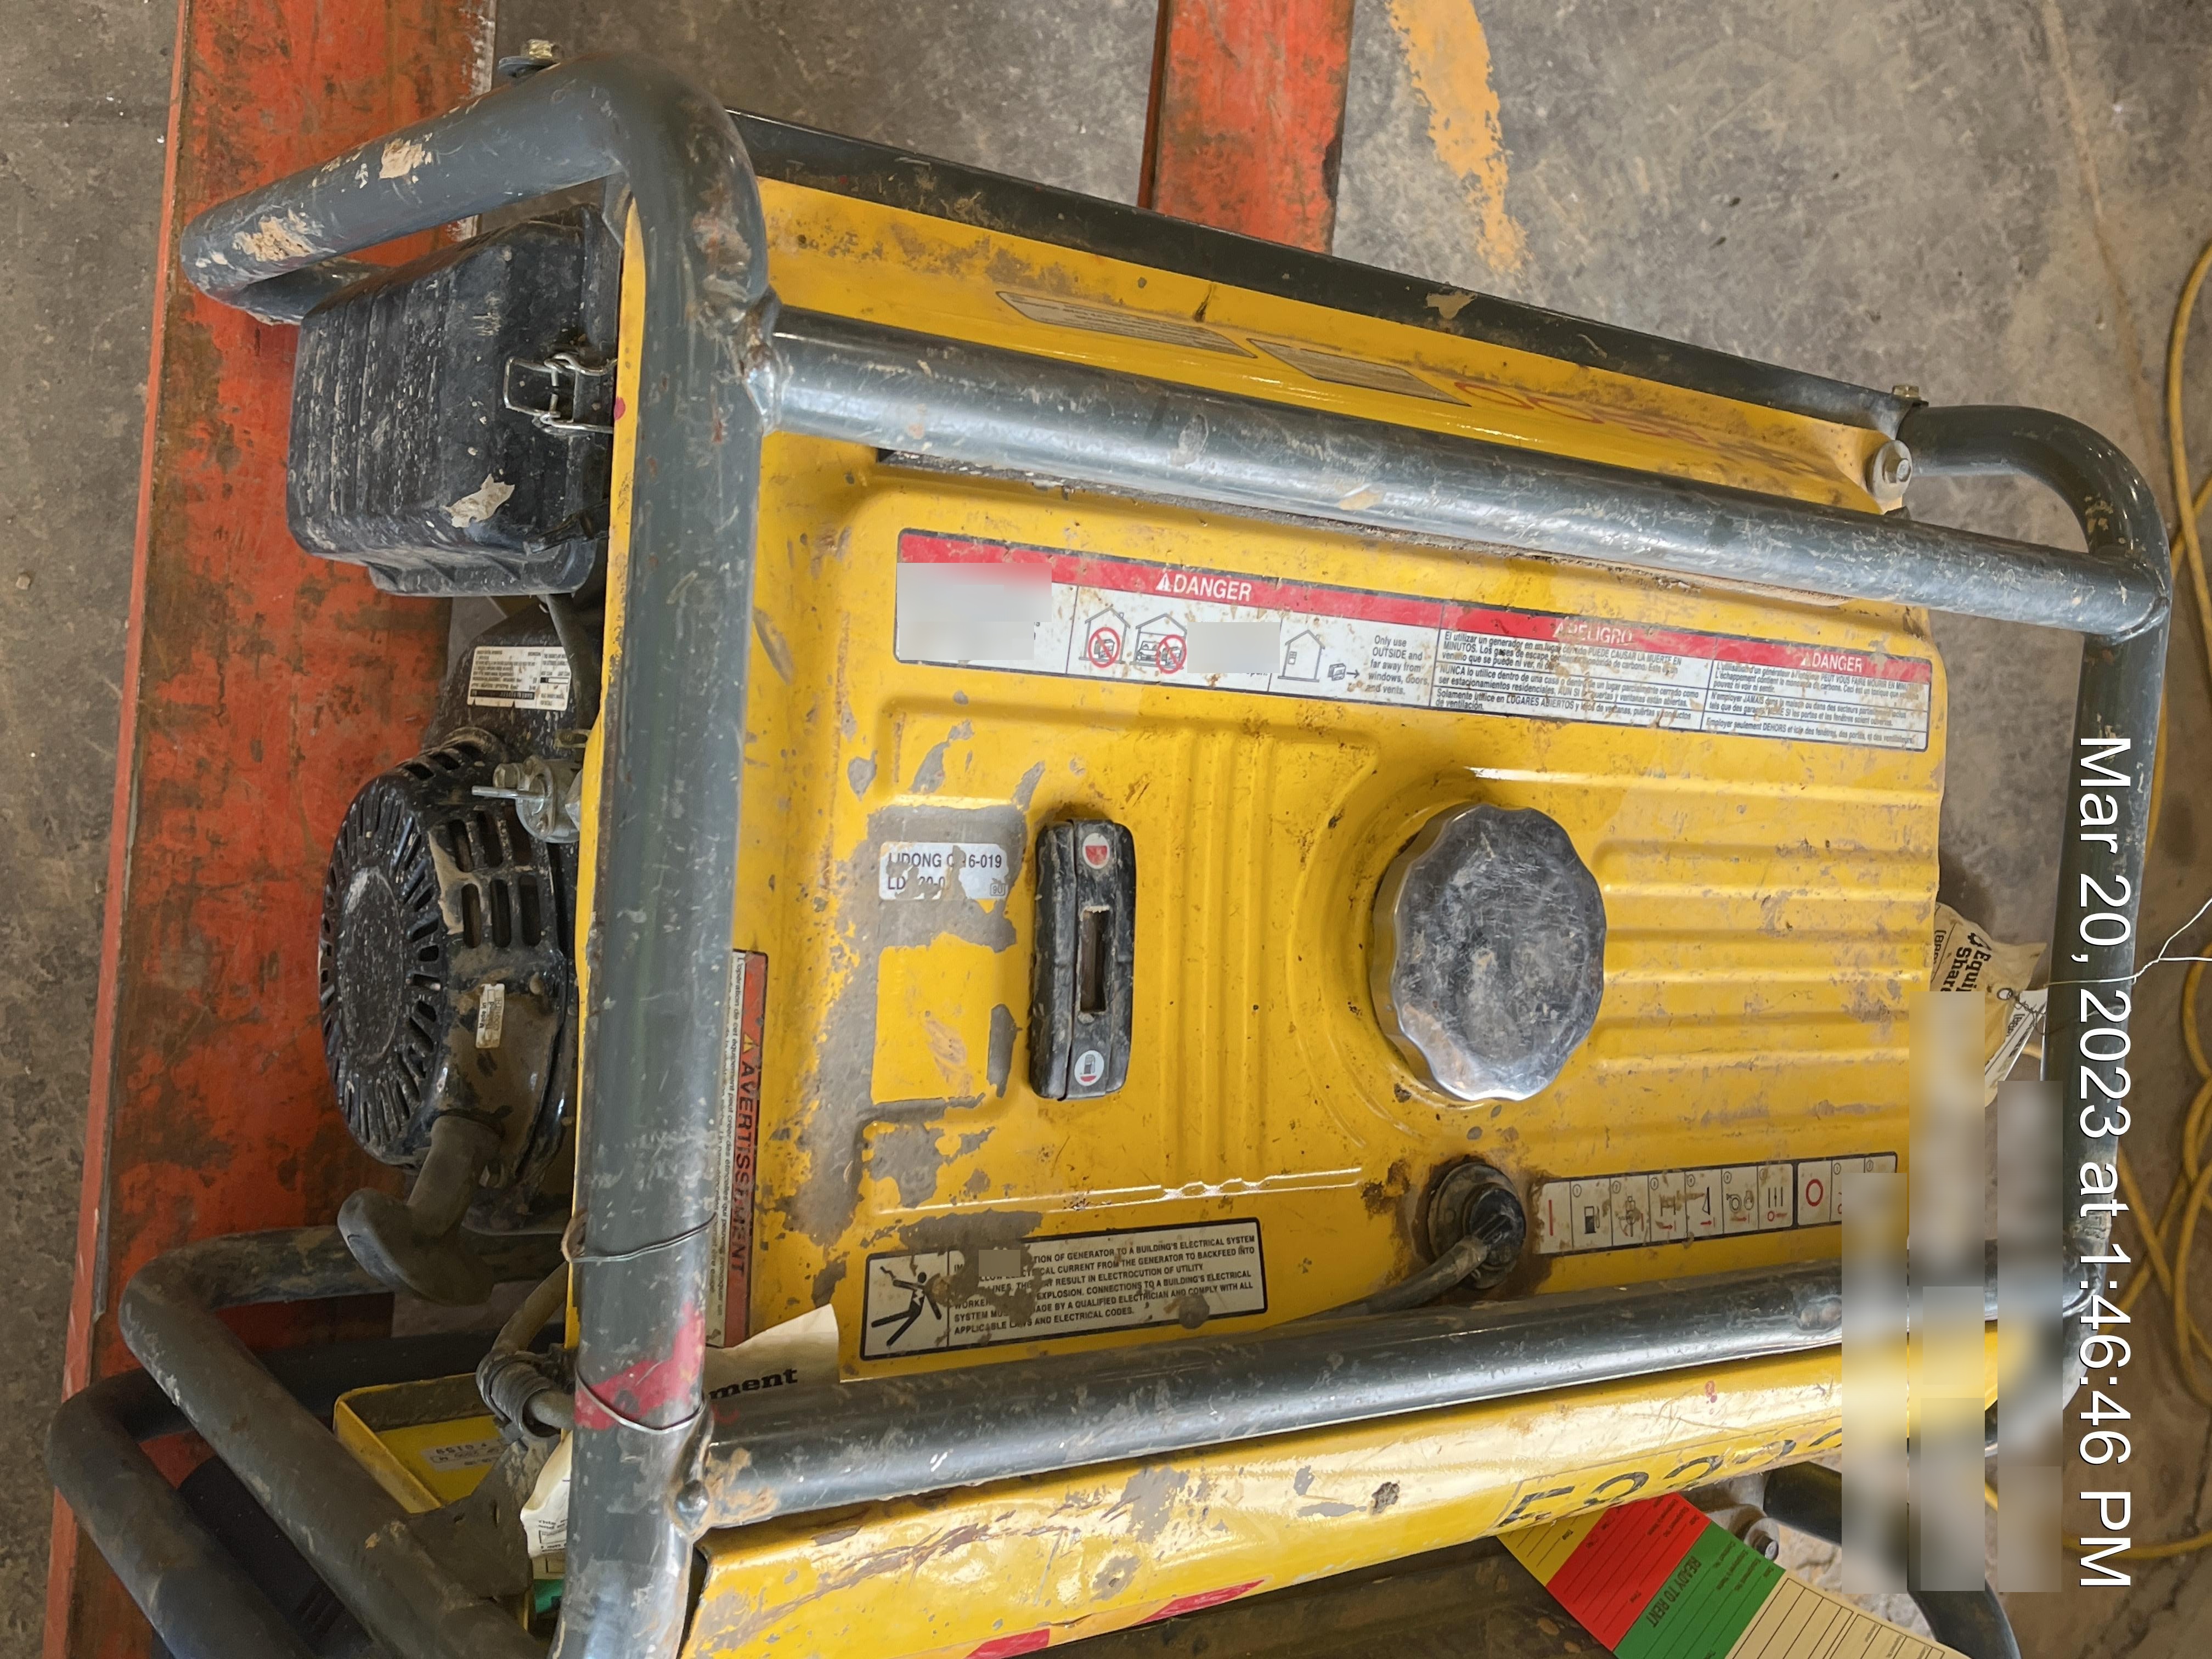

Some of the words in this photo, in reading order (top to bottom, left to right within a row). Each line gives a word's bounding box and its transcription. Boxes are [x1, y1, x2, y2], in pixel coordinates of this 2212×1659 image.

[1173, 573, 1251, 602] DANGER
[1374, 634, 1391, 647] Only
[1393, 638, 1407, 647] use
[1444, 631, 1452, 640] El
[1453, 632, 1476, 642] utilizar
[1488, 636, 1523, 650] generador
[1587, 647, 1609, 657] PUEDE
[1610, 650, 1637, 660] CAUSAR
[1637, 652, 1645, 661] LA
[1646, 653, 1672, 664] MUERTE
[1673, 657, 1681, 665] EN
[1372, 646, 1406, 659] OUTSIDE
[1408, 650, 1423, 661] and
[1443, 641, 1478, 653] MINUTOS.
[1479, 645, 1492, 654] Los
[1493, 647, 1514, 658] gases
[1515, 648, 1524, 657] de
[1525, 651, 1549, 662] escape
[1468, 654, 1481, 665] que
[1492, 656, 1513, 669] puede
[1515, 658, 1521, 667] ni
[1370, 658, 1381, 668] far
[1382, 662, 1401, 673] away
[1403, 661, 1421, 673] from
[1812, 652, 1861, 673] DANGER
[1368, 670, 1404, 684] windows,
[1405, 674, 1430, 686] doors,
[1439, 664, 1466, 675] NUNCA
[1467, 667, 1474, 676] lo
[1475, 667, 1497, 678] utilice
[1497, 670, 1520, 680] dentro
[1521, 672, 1530, 681] de
[1530, 674, 1543, 682] una
[1544, 676, 1559, 684] casa
[1821, 674, 1834, 682] PEUT
[1365, 682, 1381, 692] and
[1382, 684, 1406, 695] vents.
[1451, 676, 1510, 690] estacionamientos
[1511, 682, 1556, 695] residenciales,
[1435, 697, 1444, 706] de
[1445, 698, 1485, 710] ventilación.
[1436, 687, 1472, 700] Solamente
[1496, 695, 1504, 703] en
[1506, 695, 1539, 706] LUGARES
[1540, 698, 1574, 709] ABIERTOS
[1763, 723, 1786, 732] DEHORS
[1956, 950, 1991, 991] Equi
[734, 958, 744, 1006] L'opération
[733, 1009, 740, 1019] de
[728, 1039, 738, 1090] équipement
[726, 1093, 735, 1111] peut
[722, 1159, 730, 1203] étincelles
[1054, 1252, 1065, 1261] OF
[1066, 1247, 1114, 1260] GENERATOR
[1117, 1246, 1126, 1255] TO
[1136, 1242, 1177, 1253] BUILDING'S
[1180, 1237, 1224, 1249] ELECTRICAL
[1226, 1234, 1255, 1244] SYSTEM
[1057, 1263, 1094, 1273] CURRENT
[1097, 1260, 1119, 1269] FROM
[1121, 1258, 1135, 1266] THE
[1138, 1254, 1183, 1265] GENERATOR
[1186, 1252, 1195, 1260] TO
[1197, 1248, 1236, 1259] BACKFEED
[1238, 1246, 1255, 1255] INTO
[1056, 1276, 1086, 1285] RESULT
[1088, 1274, 1095, 1282] IN
[1098, 1267, 1161, 1280] ELECTROCUTION
[1164, 1266, 1174, 1274] OF
[1176, 1263, 1204, 1273] UTILITY
[1036, 1288, 1084, 1300] EXPLOSION.
[1086, 1282, 1142, 1294] CONNECTIONS
[1144, 1280, 1154, 1288] TO
[1163, 1274, 1205, 1286] BUILDING'S
[1206, 1270, 1251, 1282] ELECTRICAL
[954, 1311, 988, 1322] SYSTEM
[1054, 1302, 1065, 1311] BY
[1075, 1296, 1116, 1308] QUALIFIED
[1119, 1291, 1169, 1303] ELECTRICIAN
[1171, 1289, 1186, 1297] AND
[1188, 1285, 1218, 1296] COMPLY
[1220, 1283, 1238, 1292] WITH
[1239, 1282, 1252, 1290] ALL
[954, 1321, 1007, 1334] APPLICABLE
[1034, 1316, 1051, 1325] AND
[1054, 1310, 1102, 1323] ELECTRICAL
[1105, 1306, 1134, 1317] CODES.
[1672, 1555, 1703, 1590] READY
[1662, 1585, 1680, 1603] TO
[1643, 1597, 1671, 1628] RENT
